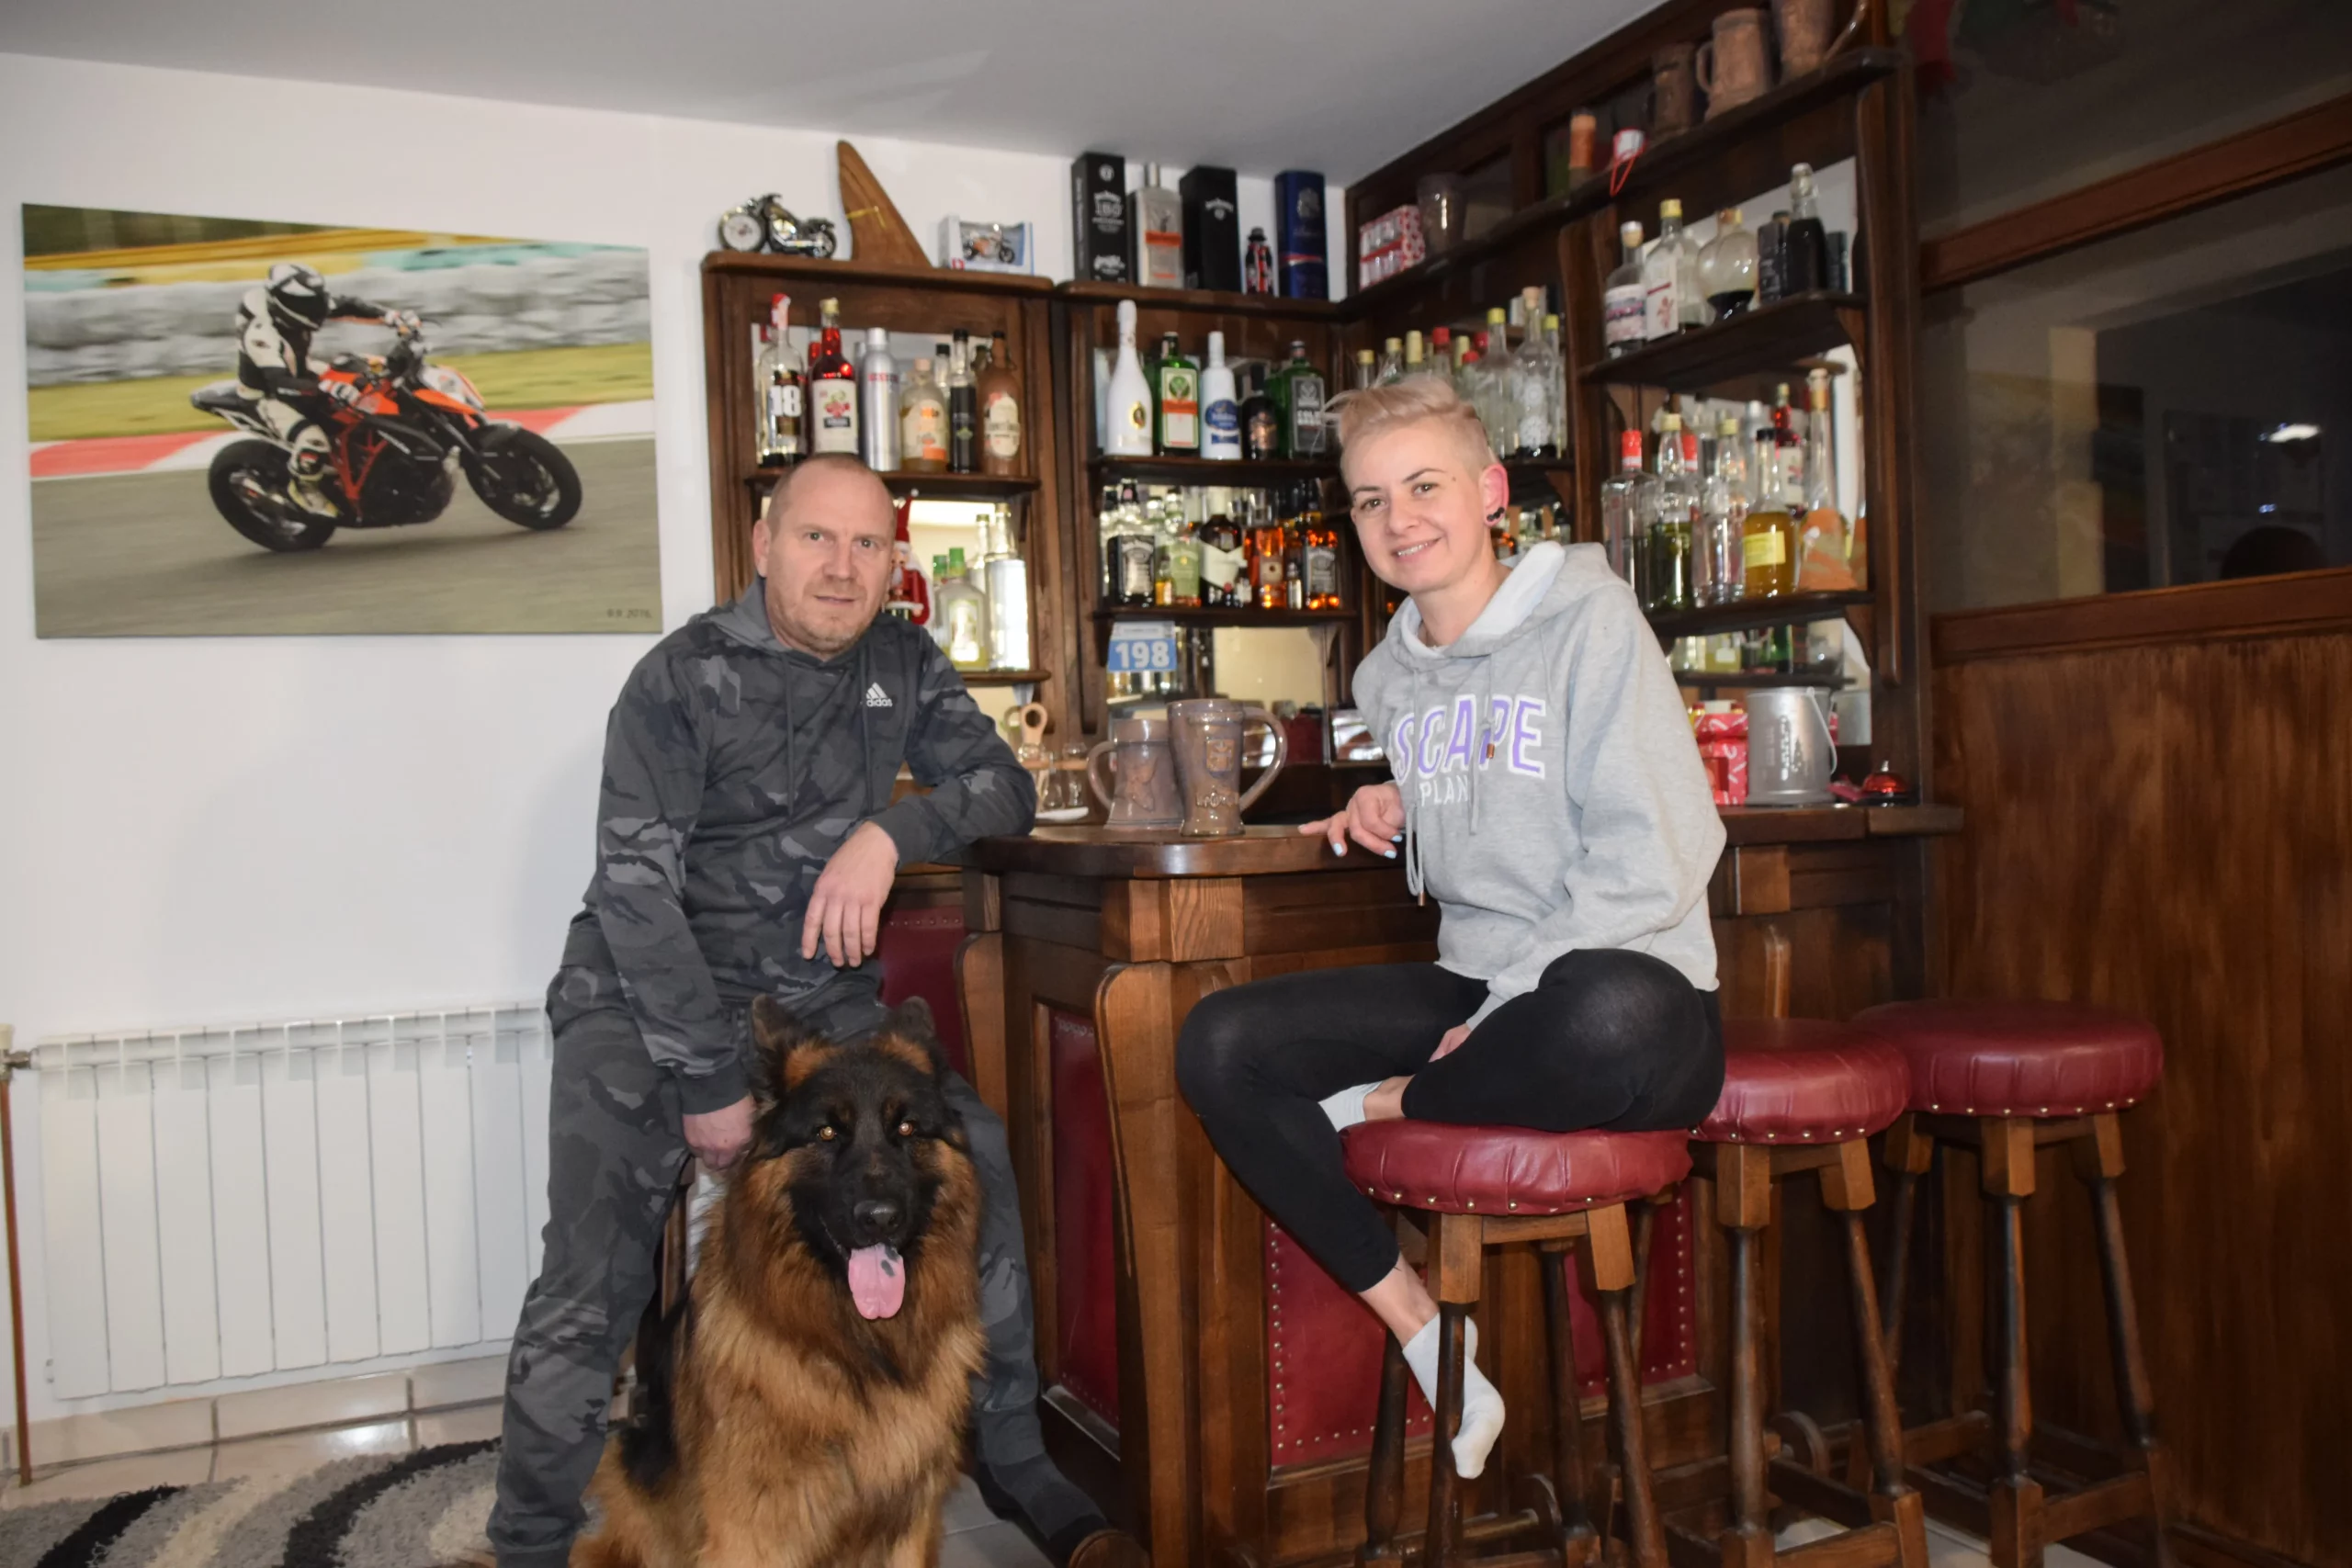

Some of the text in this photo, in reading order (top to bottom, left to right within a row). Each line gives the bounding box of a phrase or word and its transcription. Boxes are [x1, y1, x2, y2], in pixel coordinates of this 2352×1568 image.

[1114, 640, 1170, 669] 198
[865, 698, 893, 707] adidas
[1386, 693, 1546, 787] SCAPE
[1419, 765, 1469, 807] PLAN
